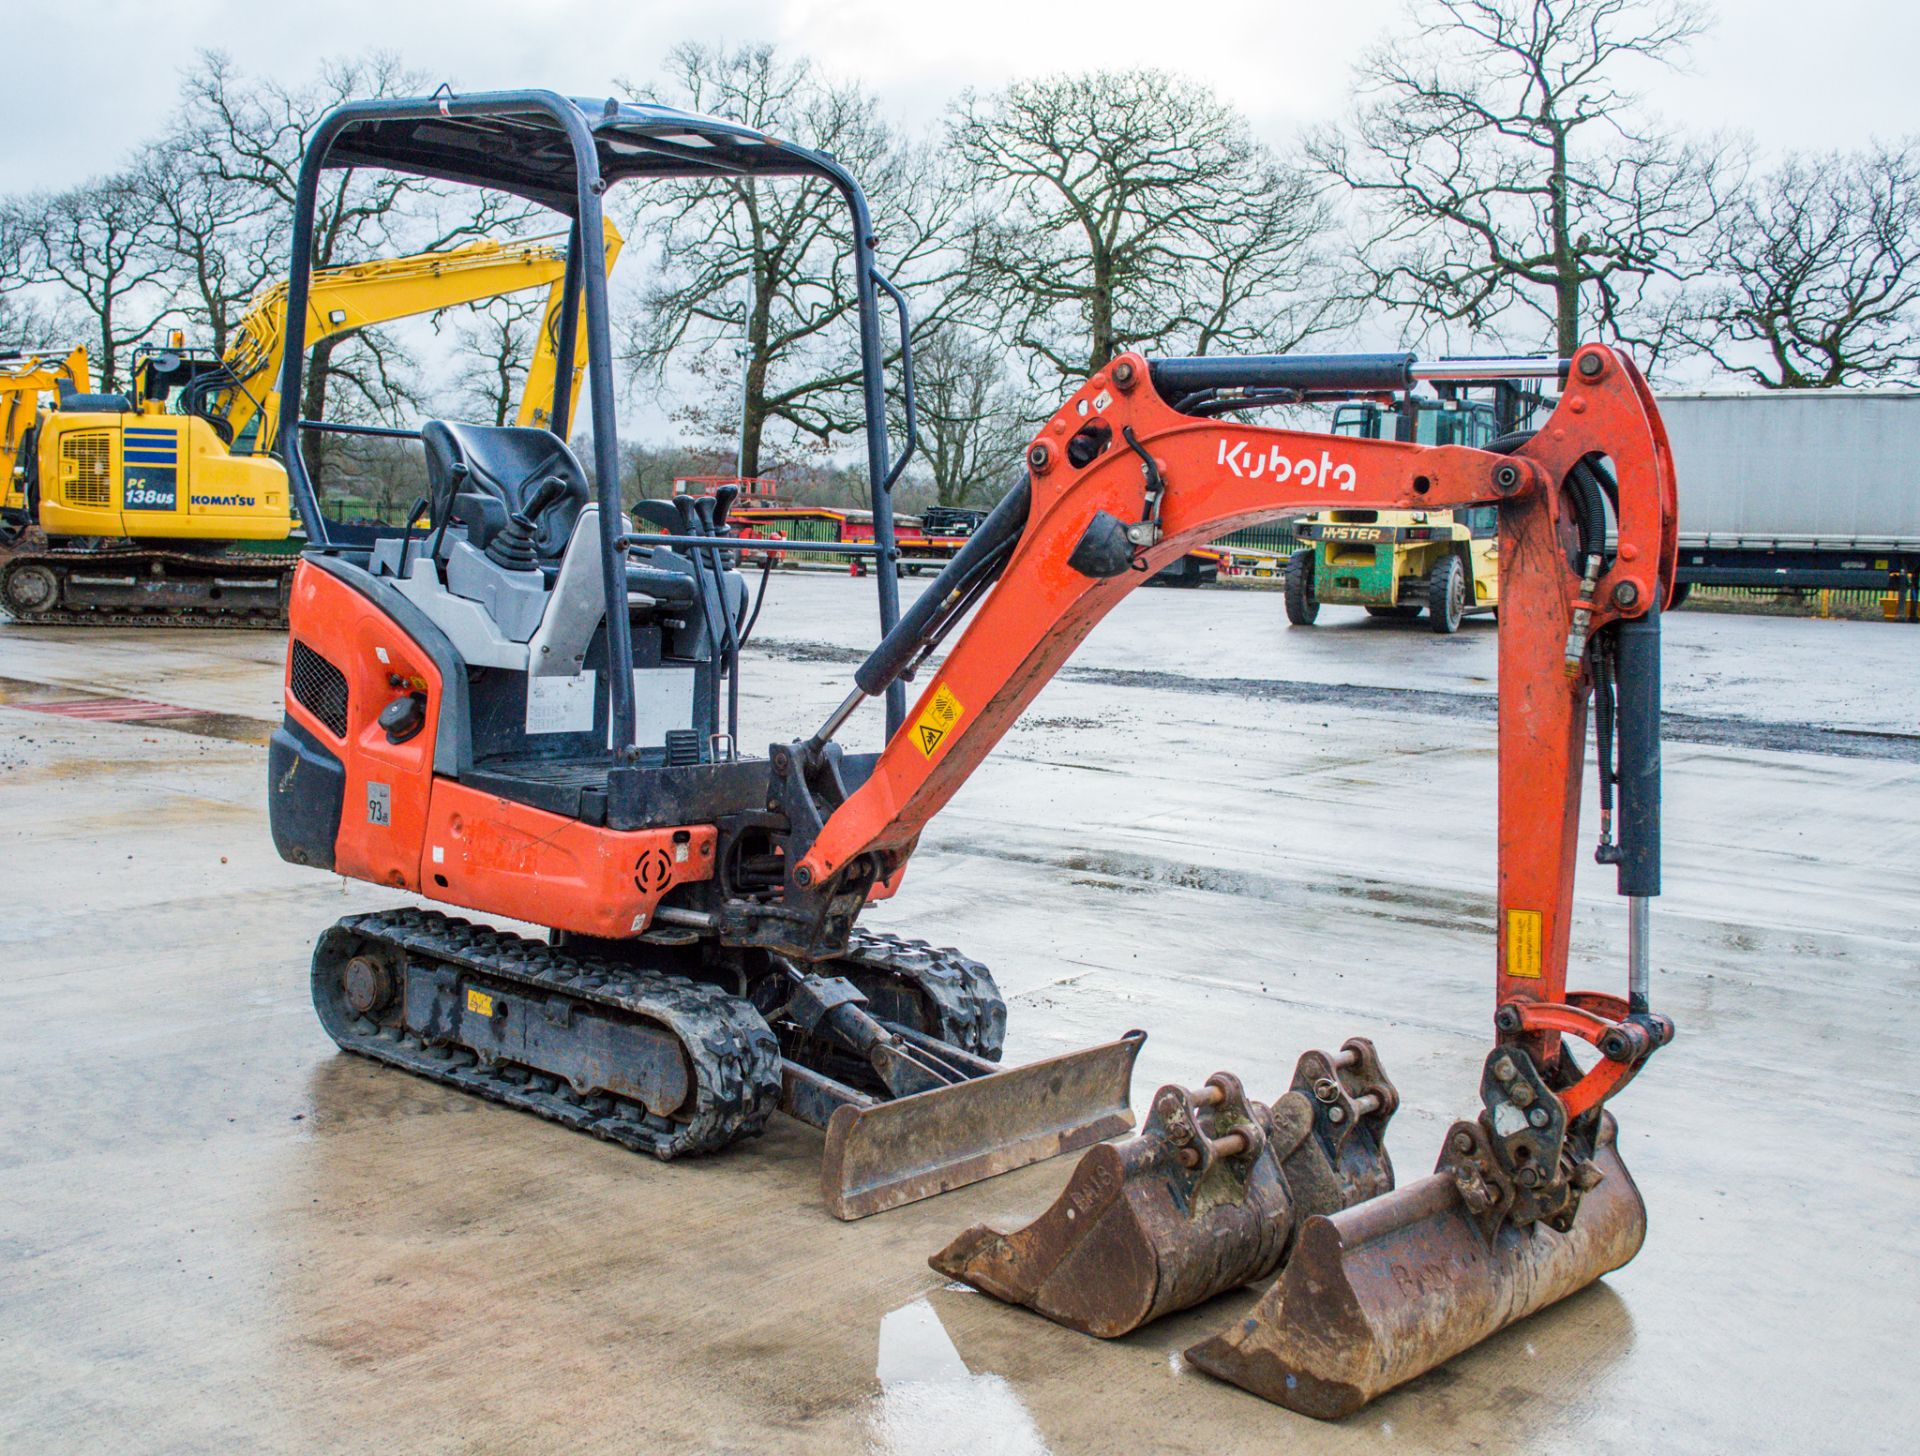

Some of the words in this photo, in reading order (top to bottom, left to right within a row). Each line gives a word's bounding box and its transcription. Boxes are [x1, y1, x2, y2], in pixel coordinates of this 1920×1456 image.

[1217, 439, 1357, 492] Kubota
[127, 478, 146, 489] PC
[190, 494, 255, 506] KOMATSU
[1322, 526, 1382, 540] HYSTER
[369, 799, 382, 821] 93
